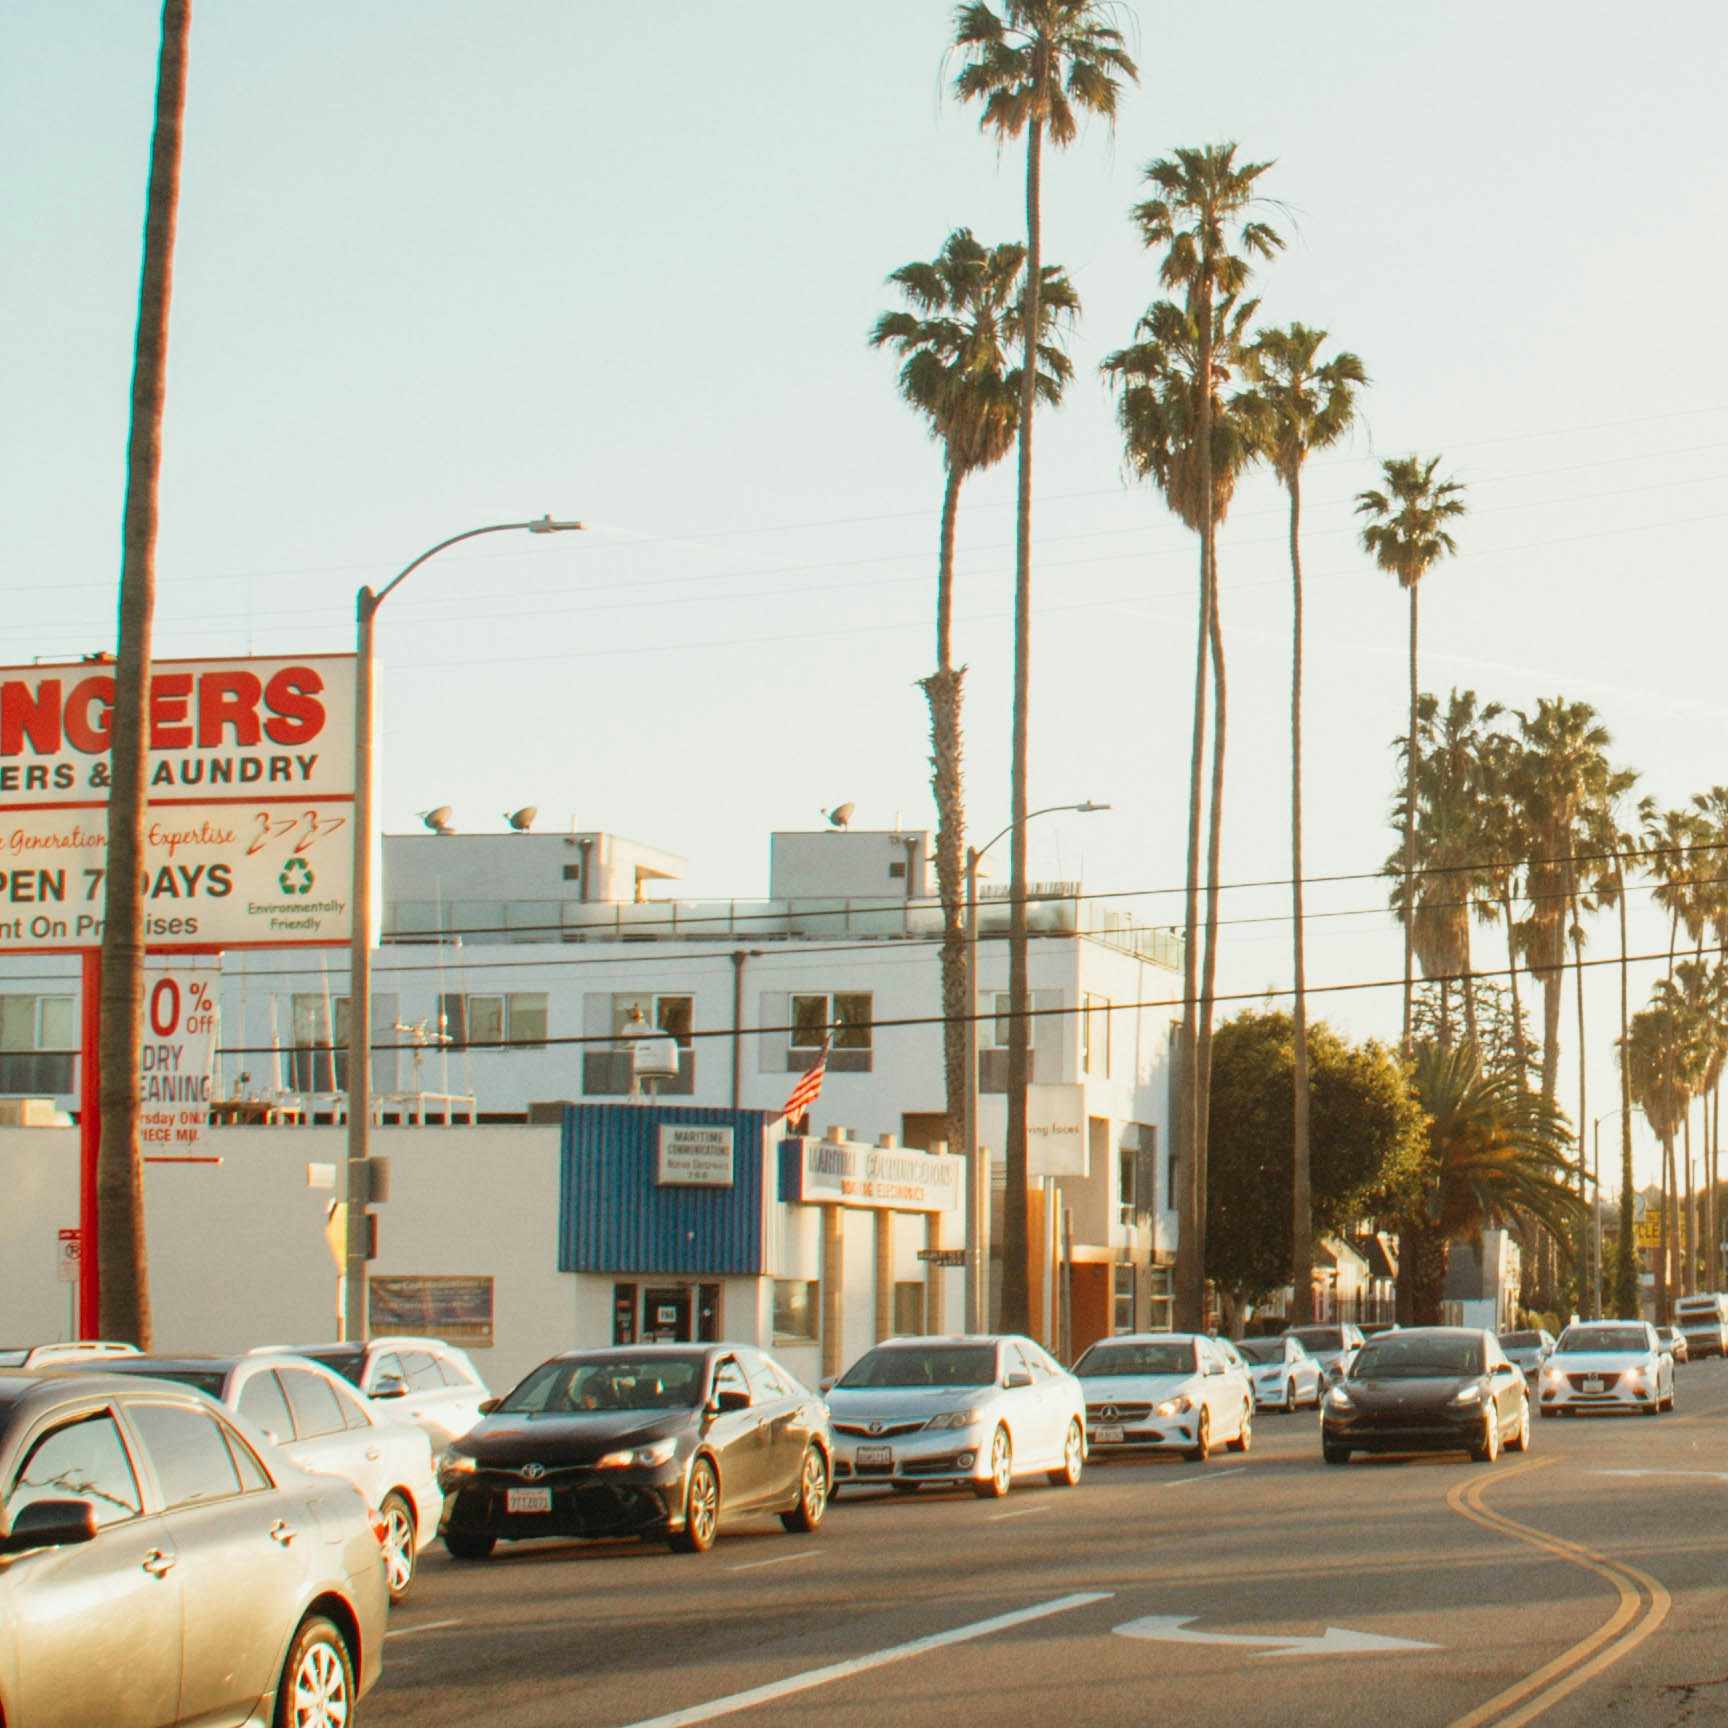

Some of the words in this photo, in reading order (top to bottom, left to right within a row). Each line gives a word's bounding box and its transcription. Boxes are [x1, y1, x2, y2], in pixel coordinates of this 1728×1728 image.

[89, 762, 112, 788] &
[151, 755, 319, 785] AUNDRY
[149, 822, 237, 857] Expertise
[0, 869, 66, 903] EN
[84, 869, 105, 901] 7
[144, 863, 234, 899] AYS
[248, 899, 346, 915] Environmentally
[31, 917, 67, 939] On
[77, 913, 199, 937] Prises
[271, 917, 322, 932] Friendly
[142, 977, 181, 1038] 0
[143, 1044, 184, 1072] DRY
